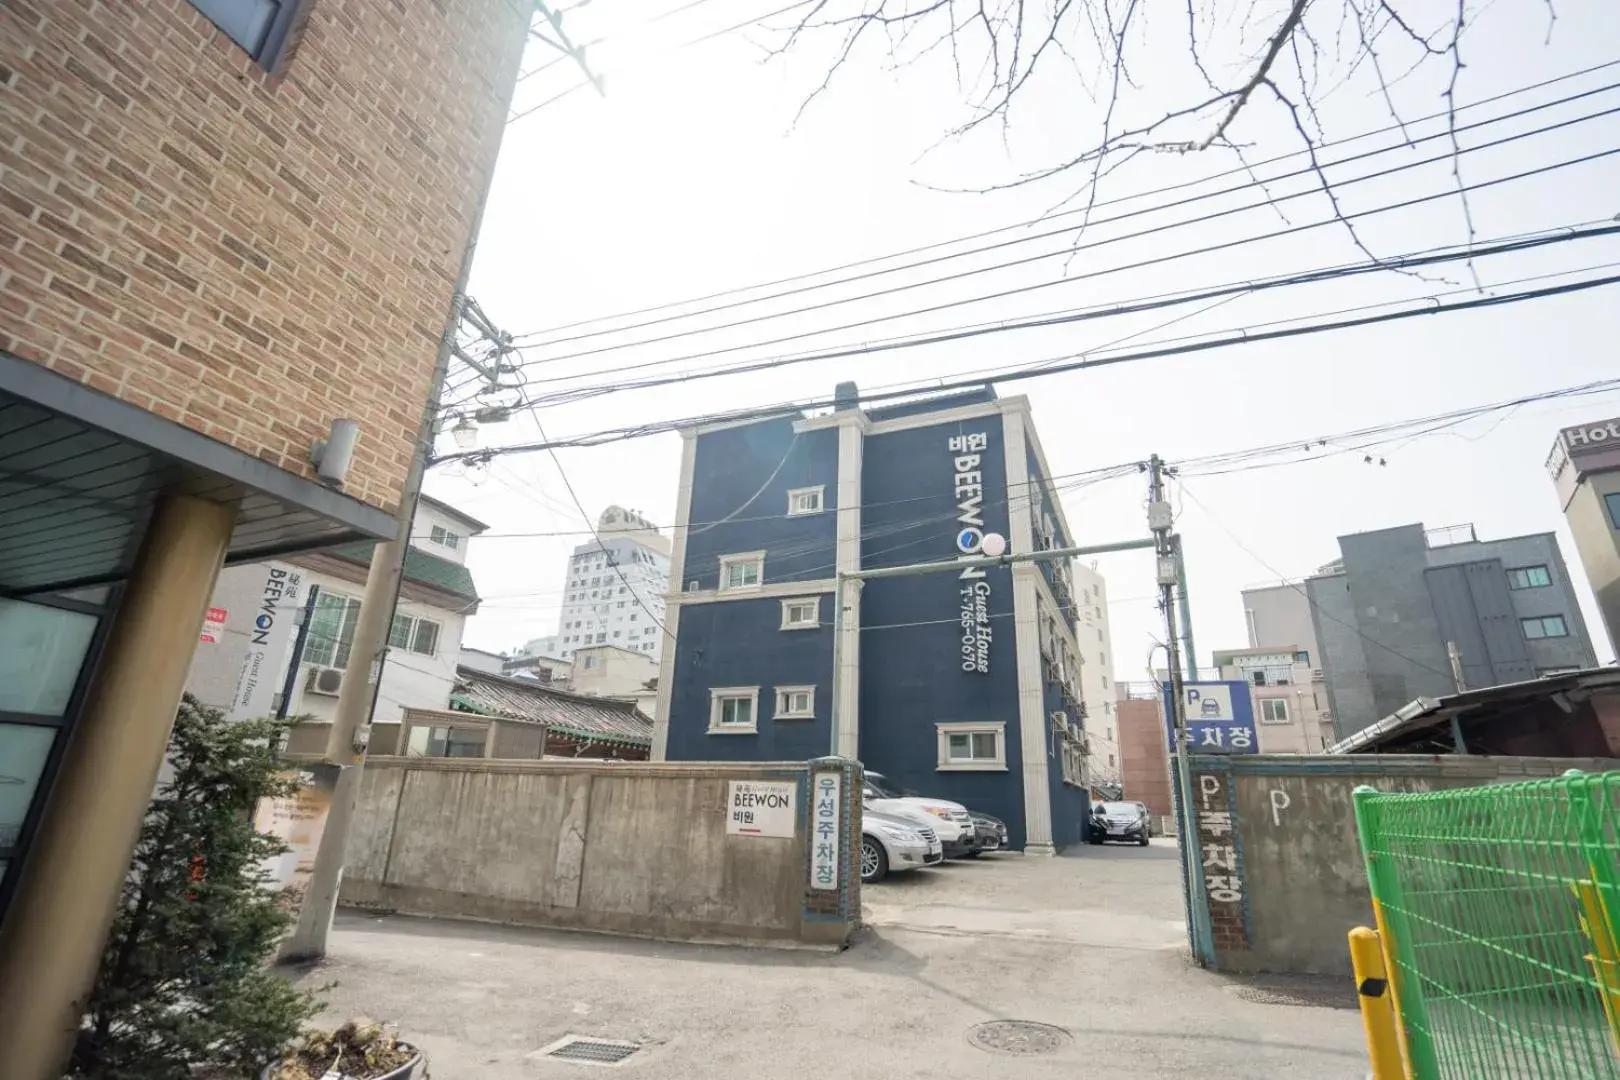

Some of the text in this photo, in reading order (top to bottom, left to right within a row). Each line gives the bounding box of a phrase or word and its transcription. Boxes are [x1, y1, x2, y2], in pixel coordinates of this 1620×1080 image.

[948, 431, 987, 453] 비원
[954, 454, 987, 580] BEEWON
[251, 568, 287, 646] BEEWON
[974, 581, 993, 673] Guest House
[1187, 688, 1200, 704] P
[733, 810, 754, 824] 비원
[734, 793, 789, 809] BEEWON
[1269, 788, 1290, 827] P
[816, 778, 836, 884] 우성주차장
[1199, 811, 1242, 903] 주차장
